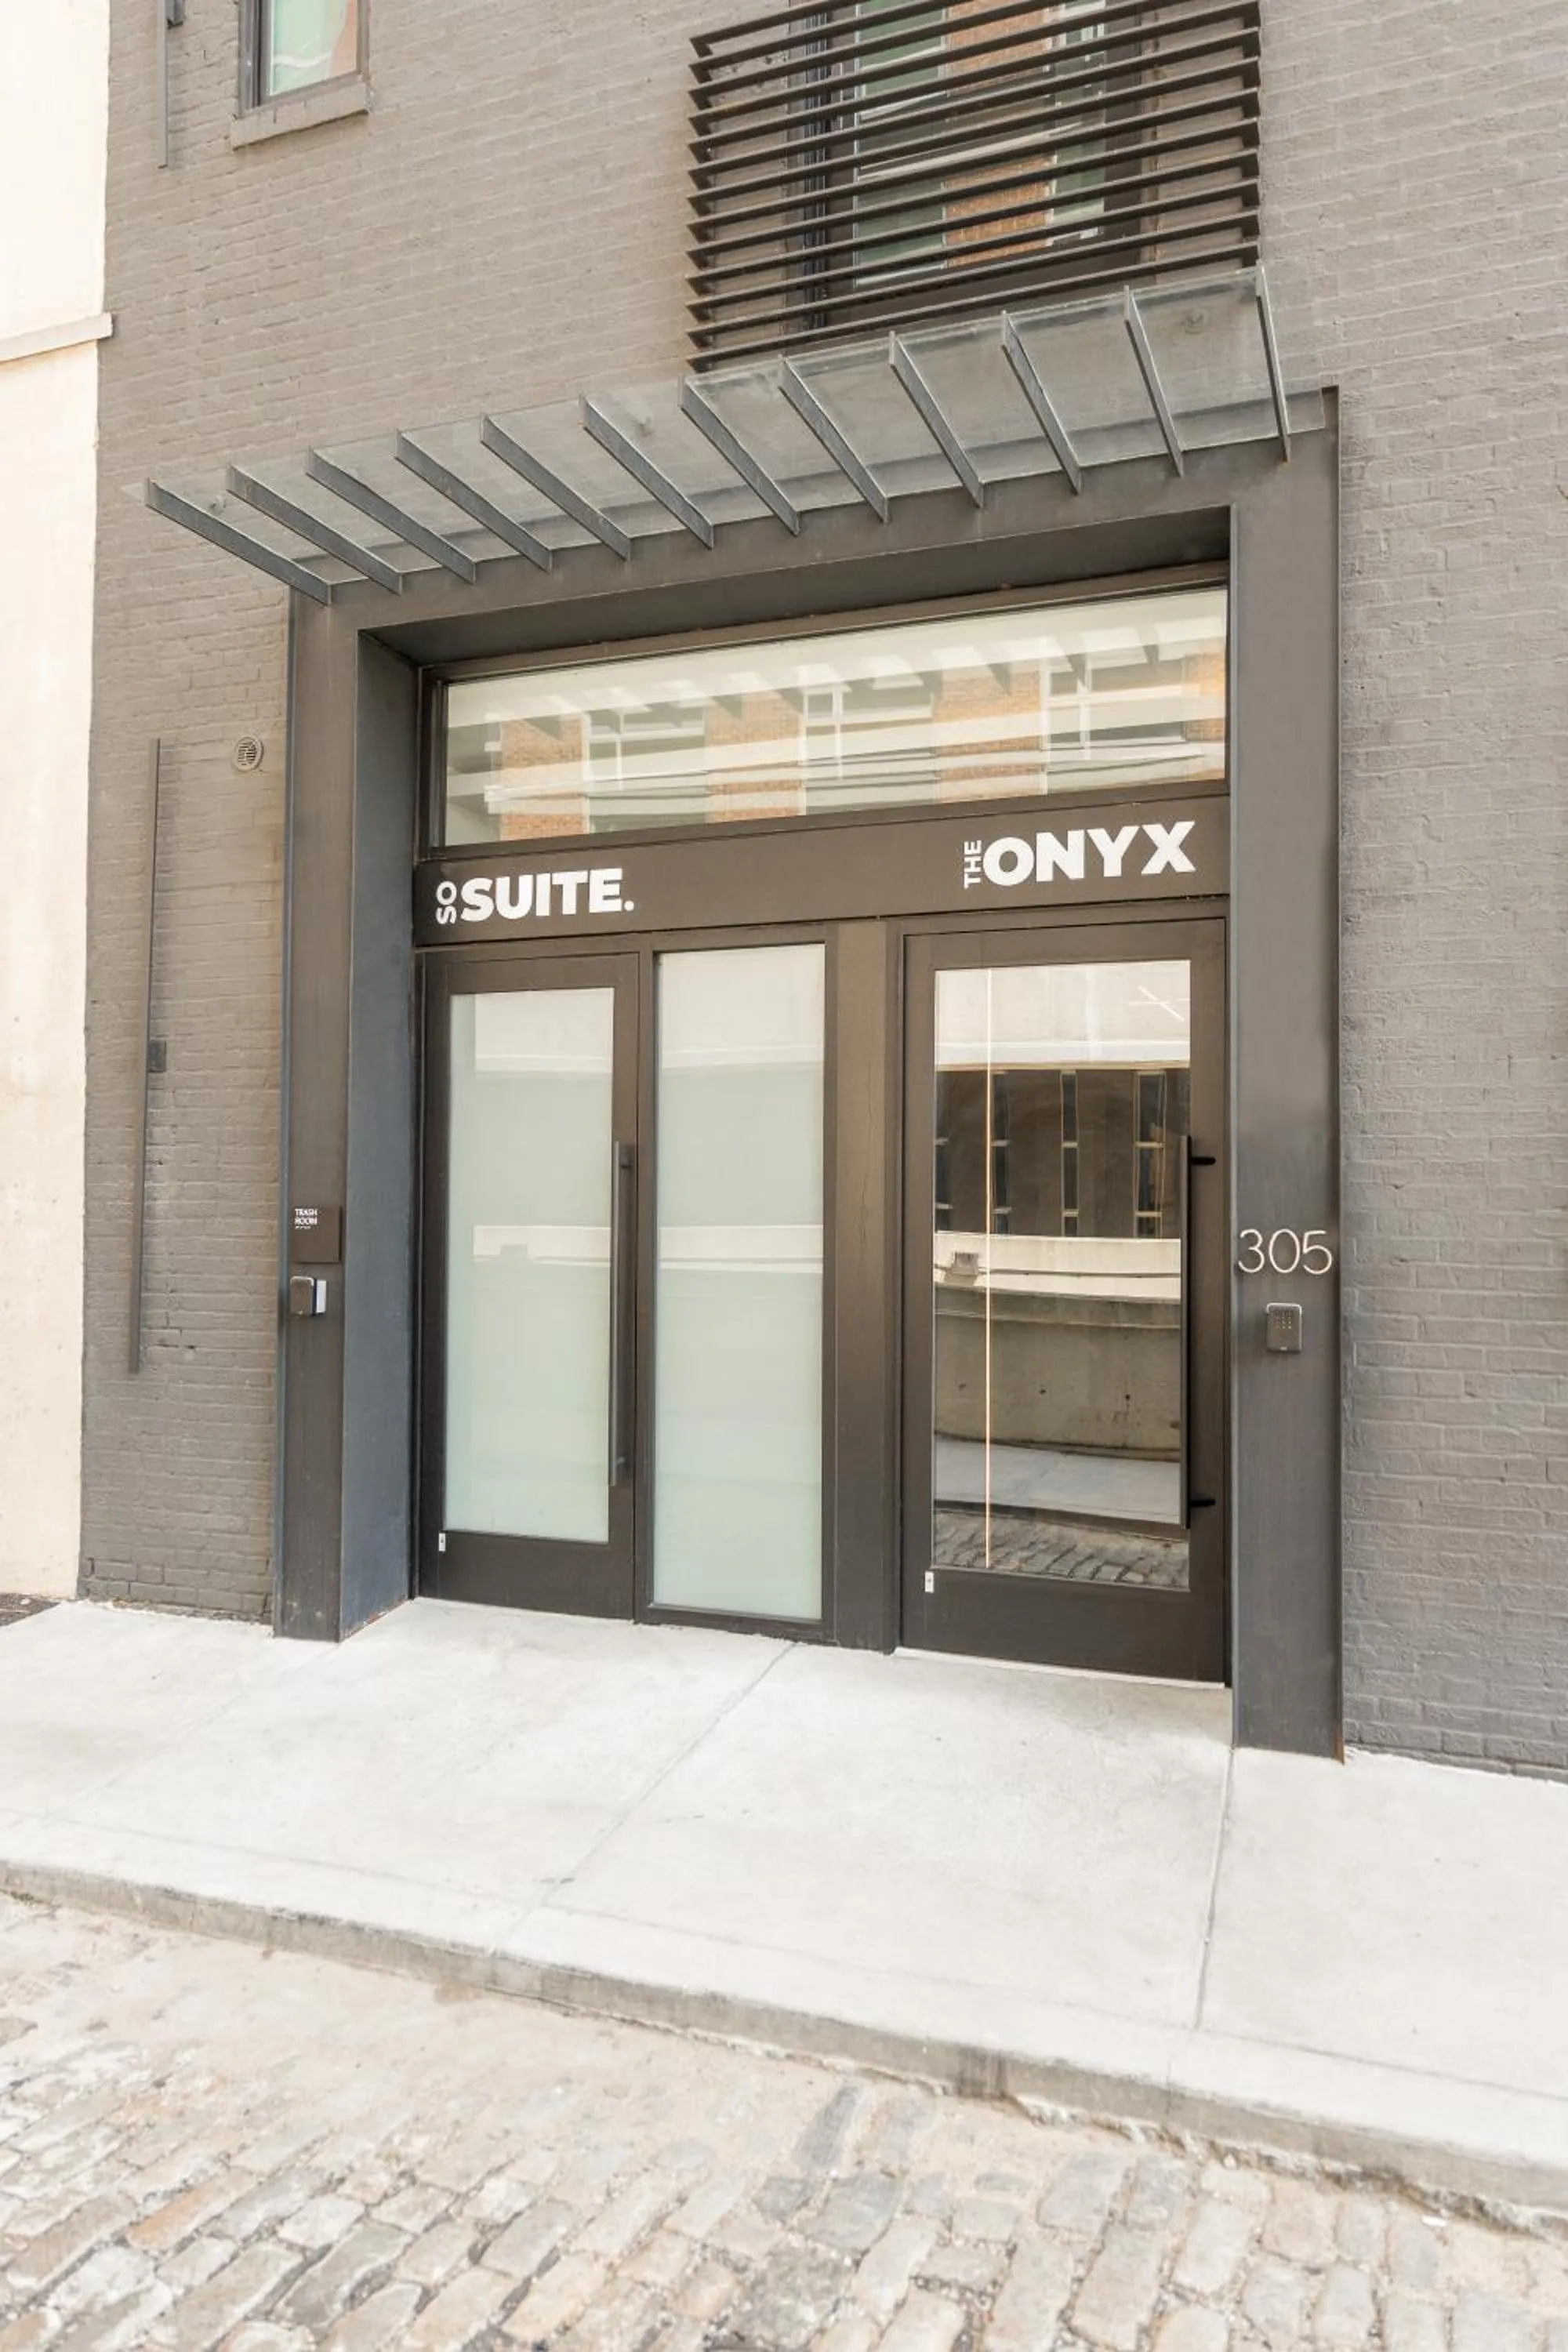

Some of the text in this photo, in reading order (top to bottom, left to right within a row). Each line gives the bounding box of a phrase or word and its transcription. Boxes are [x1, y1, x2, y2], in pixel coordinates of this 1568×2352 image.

[964, 821, 1196, 888] THE ONYX
[436, 868, 634, 924] SO SUITE.
[294, 1217, 318, 1225] ROOM
[1238, 1228, 1333, 1274] 305
